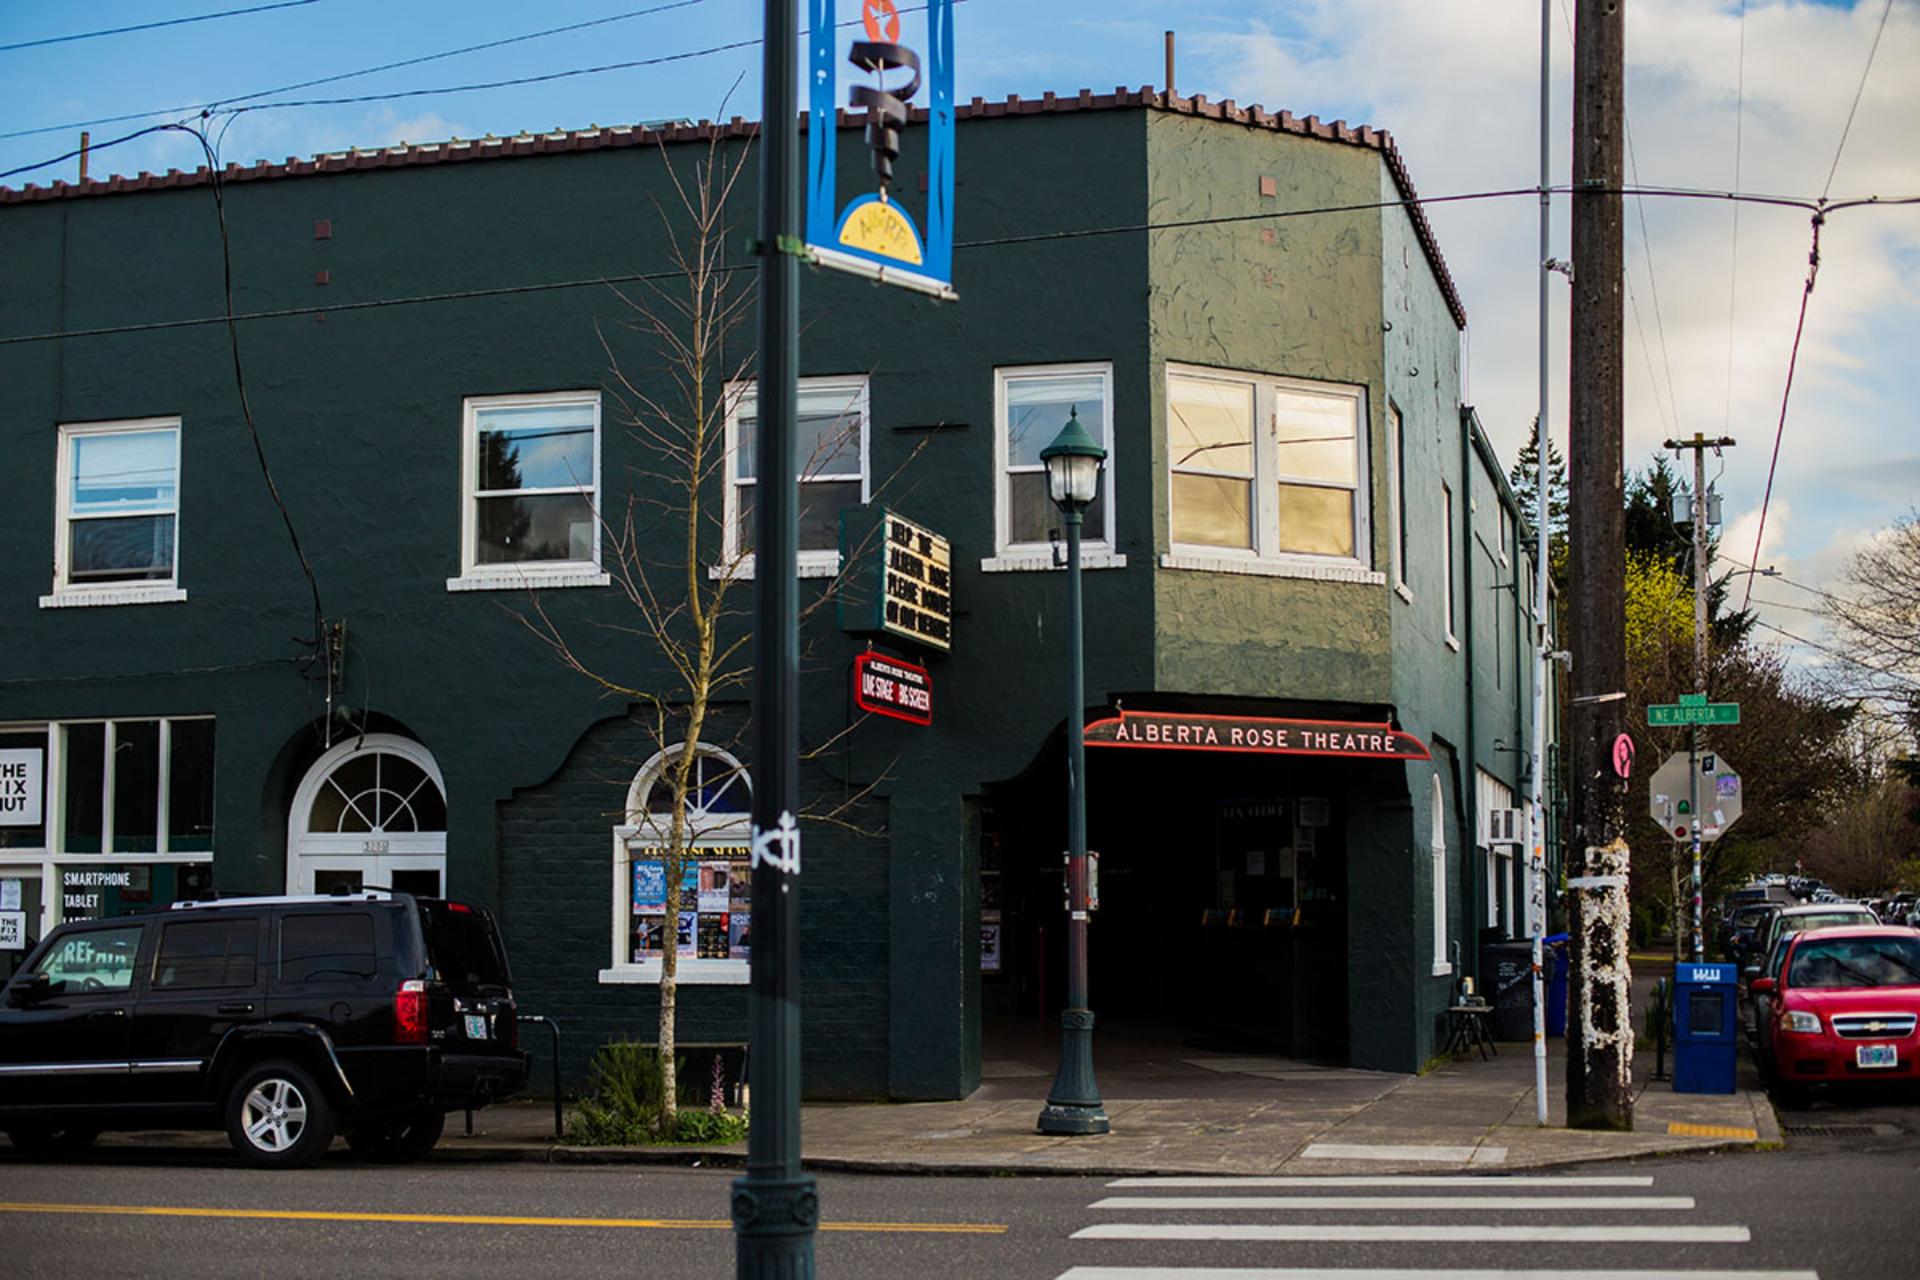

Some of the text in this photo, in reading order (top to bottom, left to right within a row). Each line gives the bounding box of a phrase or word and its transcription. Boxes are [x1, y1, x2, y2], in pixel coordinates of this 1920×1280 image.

[1655, 708, 1669, 722] NE
[1673, 707, 1716, 722] ALBERTA
[1116, 723, 1395, 752] ALBERTA ROSE THEATRE
[0, 763, 26, 778] HE
[0, 780, 26, 795] IX
[0, 796, 26, 812] UT
[64, 872, 130, 886] SMARTPHONE
[64, 894, 98, 908] TABLET
